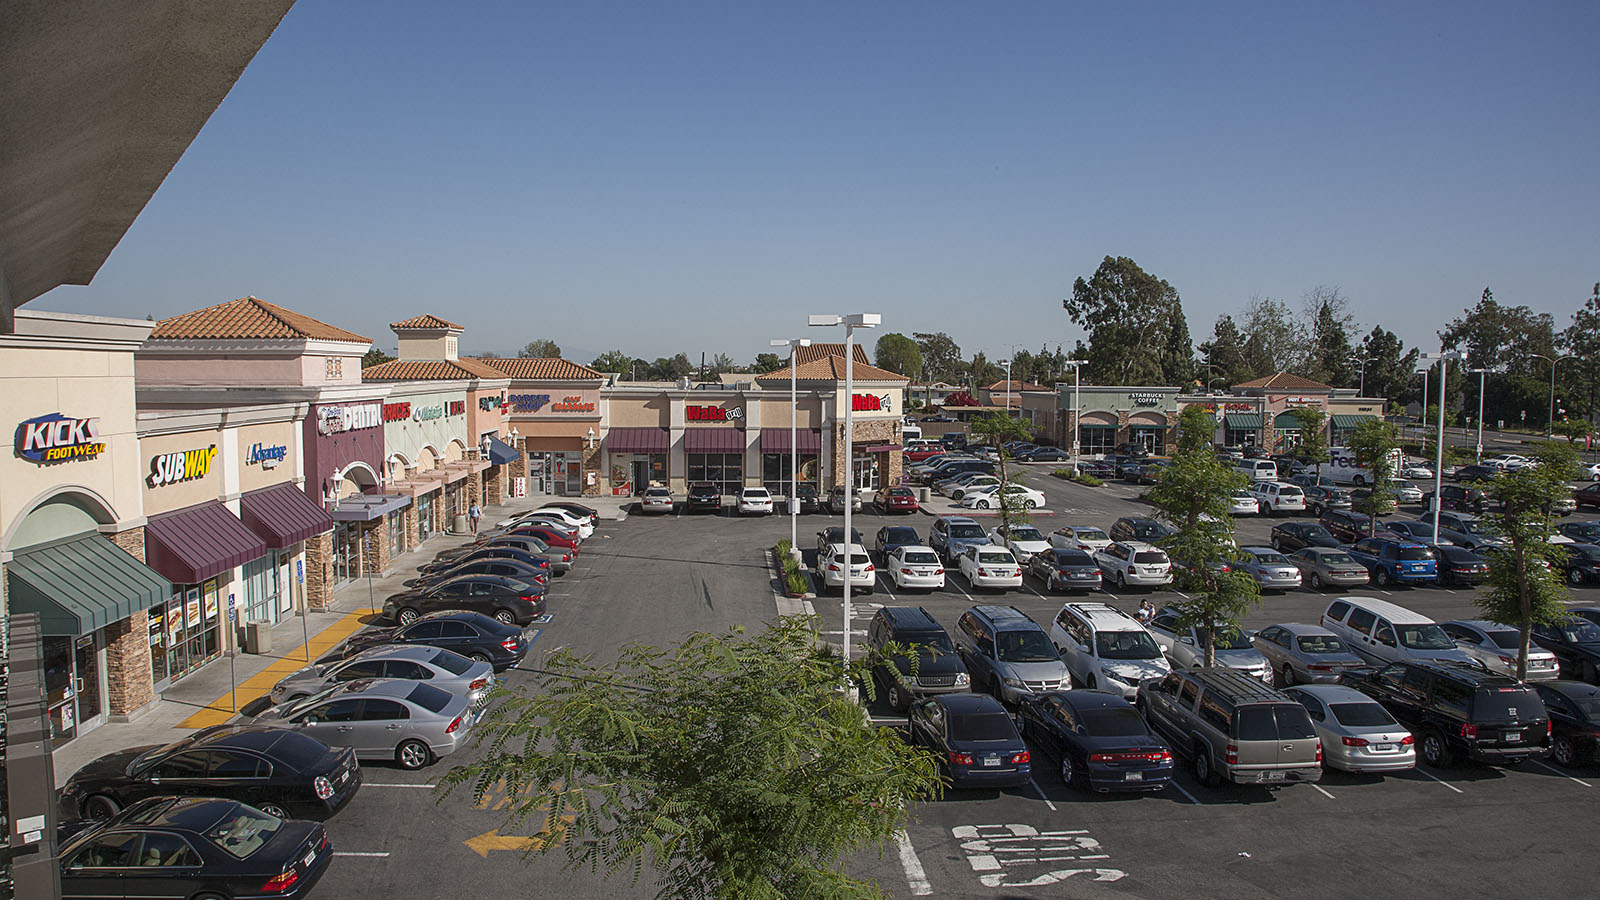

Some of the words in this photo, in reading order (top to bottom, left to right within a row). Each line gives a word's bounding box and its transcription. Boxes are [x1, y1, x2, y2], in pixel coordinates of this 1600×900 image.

[510, 394, 550, 402] BARBER
[517, 402, 544, 410] SHOP
[554, 402, 595, 410] MASSAGE
[852, 394, 881, 411] WaBa
[687, 405, 726, 421] WaBa
[22, 418, 99, 451] KICKS
[46, 443, 106, 461] FOOTWEAR
[152, 444, 218, 485] SUBWAY
